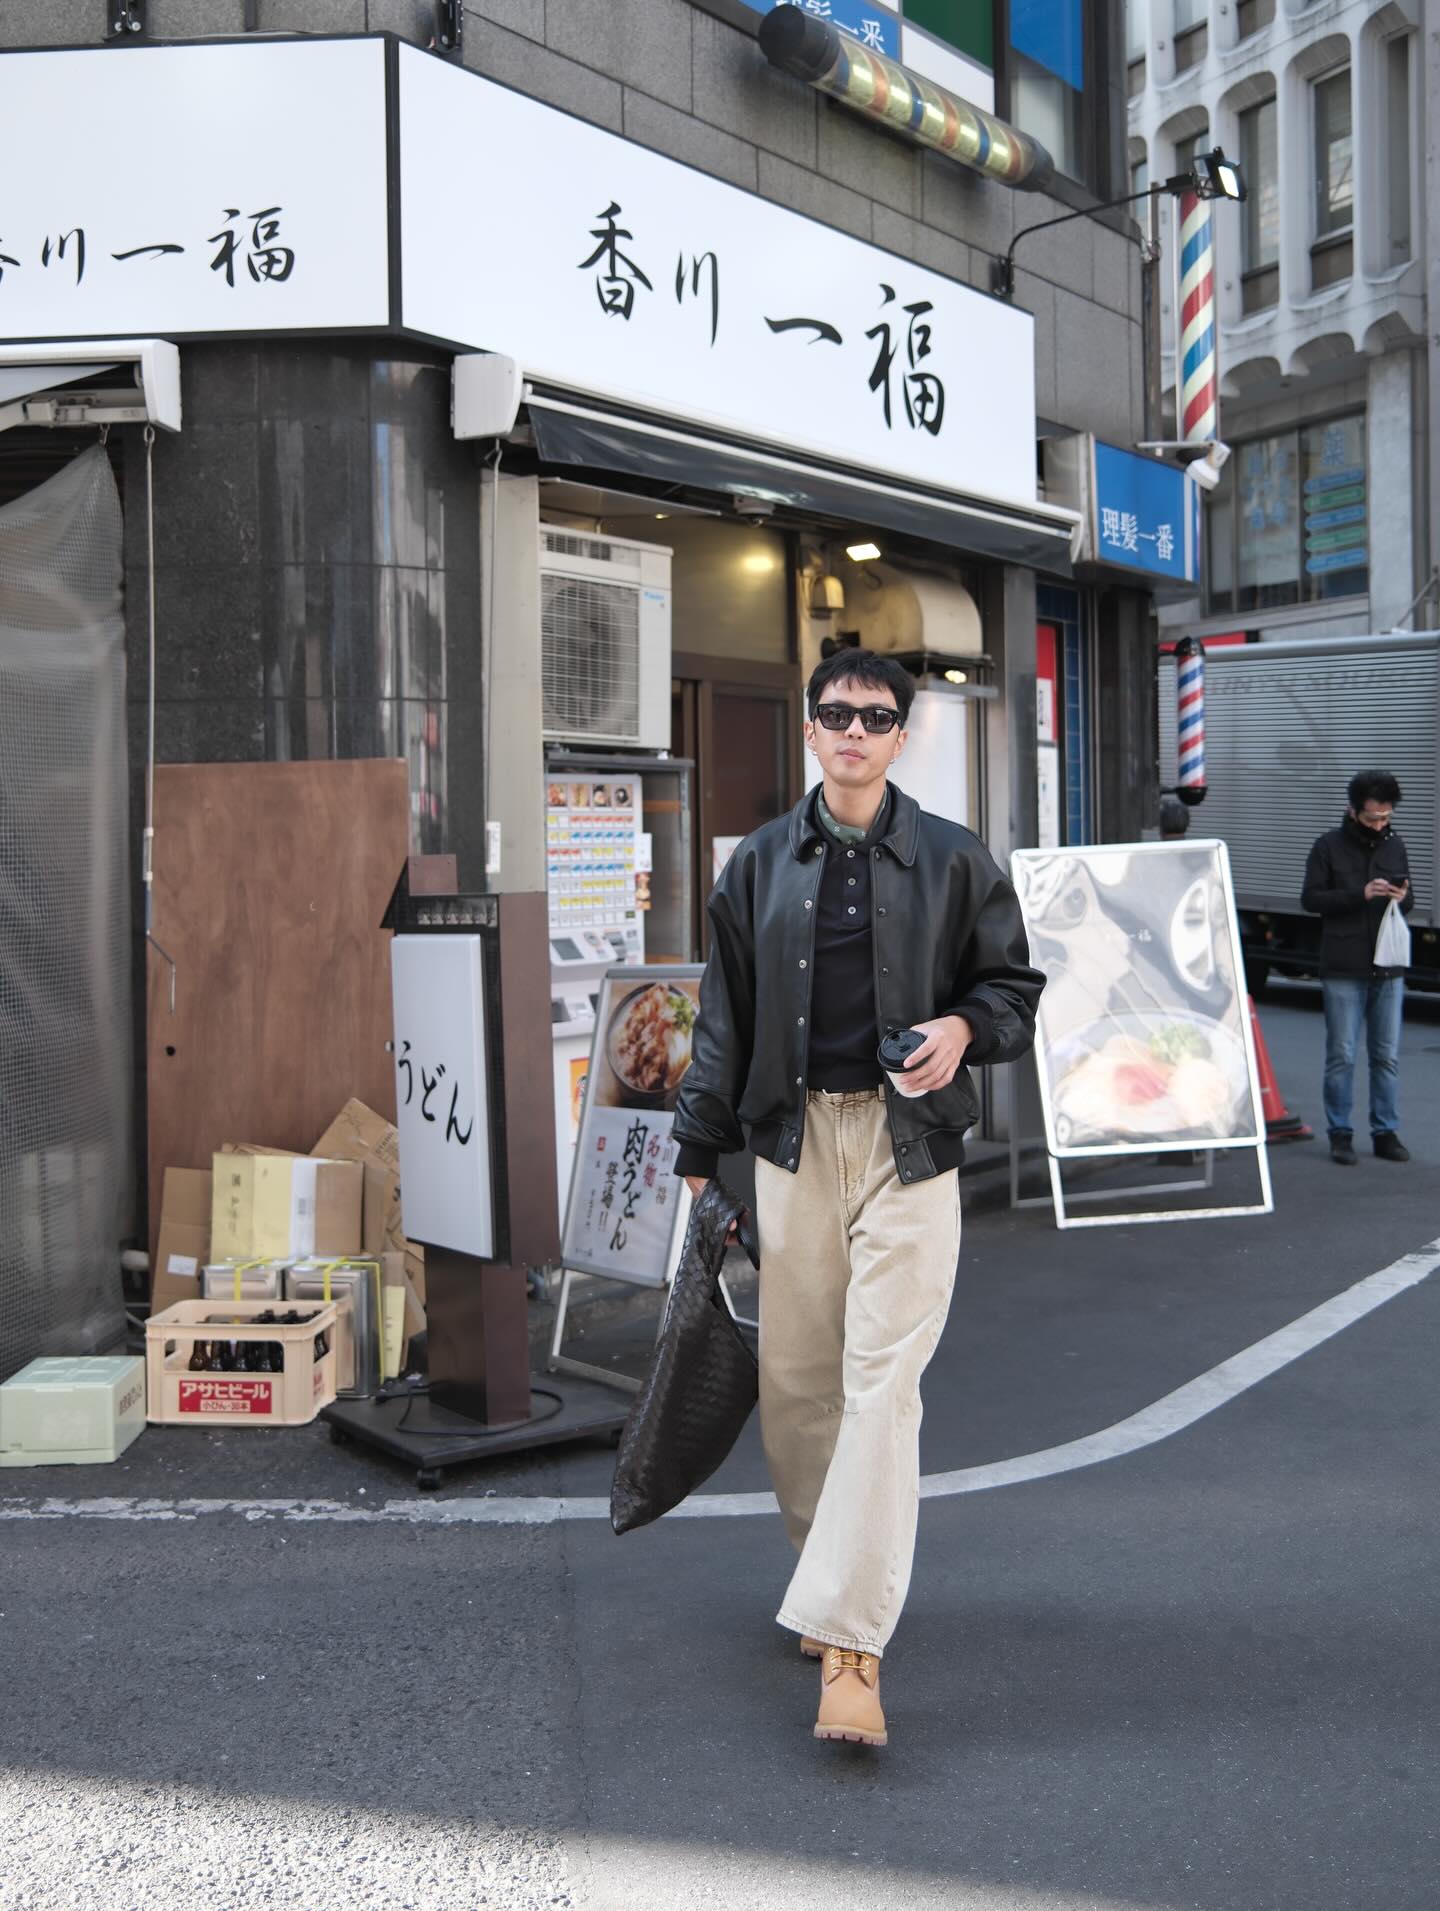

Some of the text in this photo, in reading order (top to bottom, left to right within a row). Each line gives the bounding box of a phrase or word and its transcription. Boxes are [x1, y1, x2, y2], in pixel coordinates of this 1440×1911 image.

[0, 207, 294, 287] 川一福
[578, 202, 944, 436] 香川一福
[1101, 507, 1174, 561] 理髪一番
[398, 1040, 473, 1145] うどん
[609, 1116, 649, 1251] 肉うどん
[181, 1382, 270, 1400] アサヒビール
